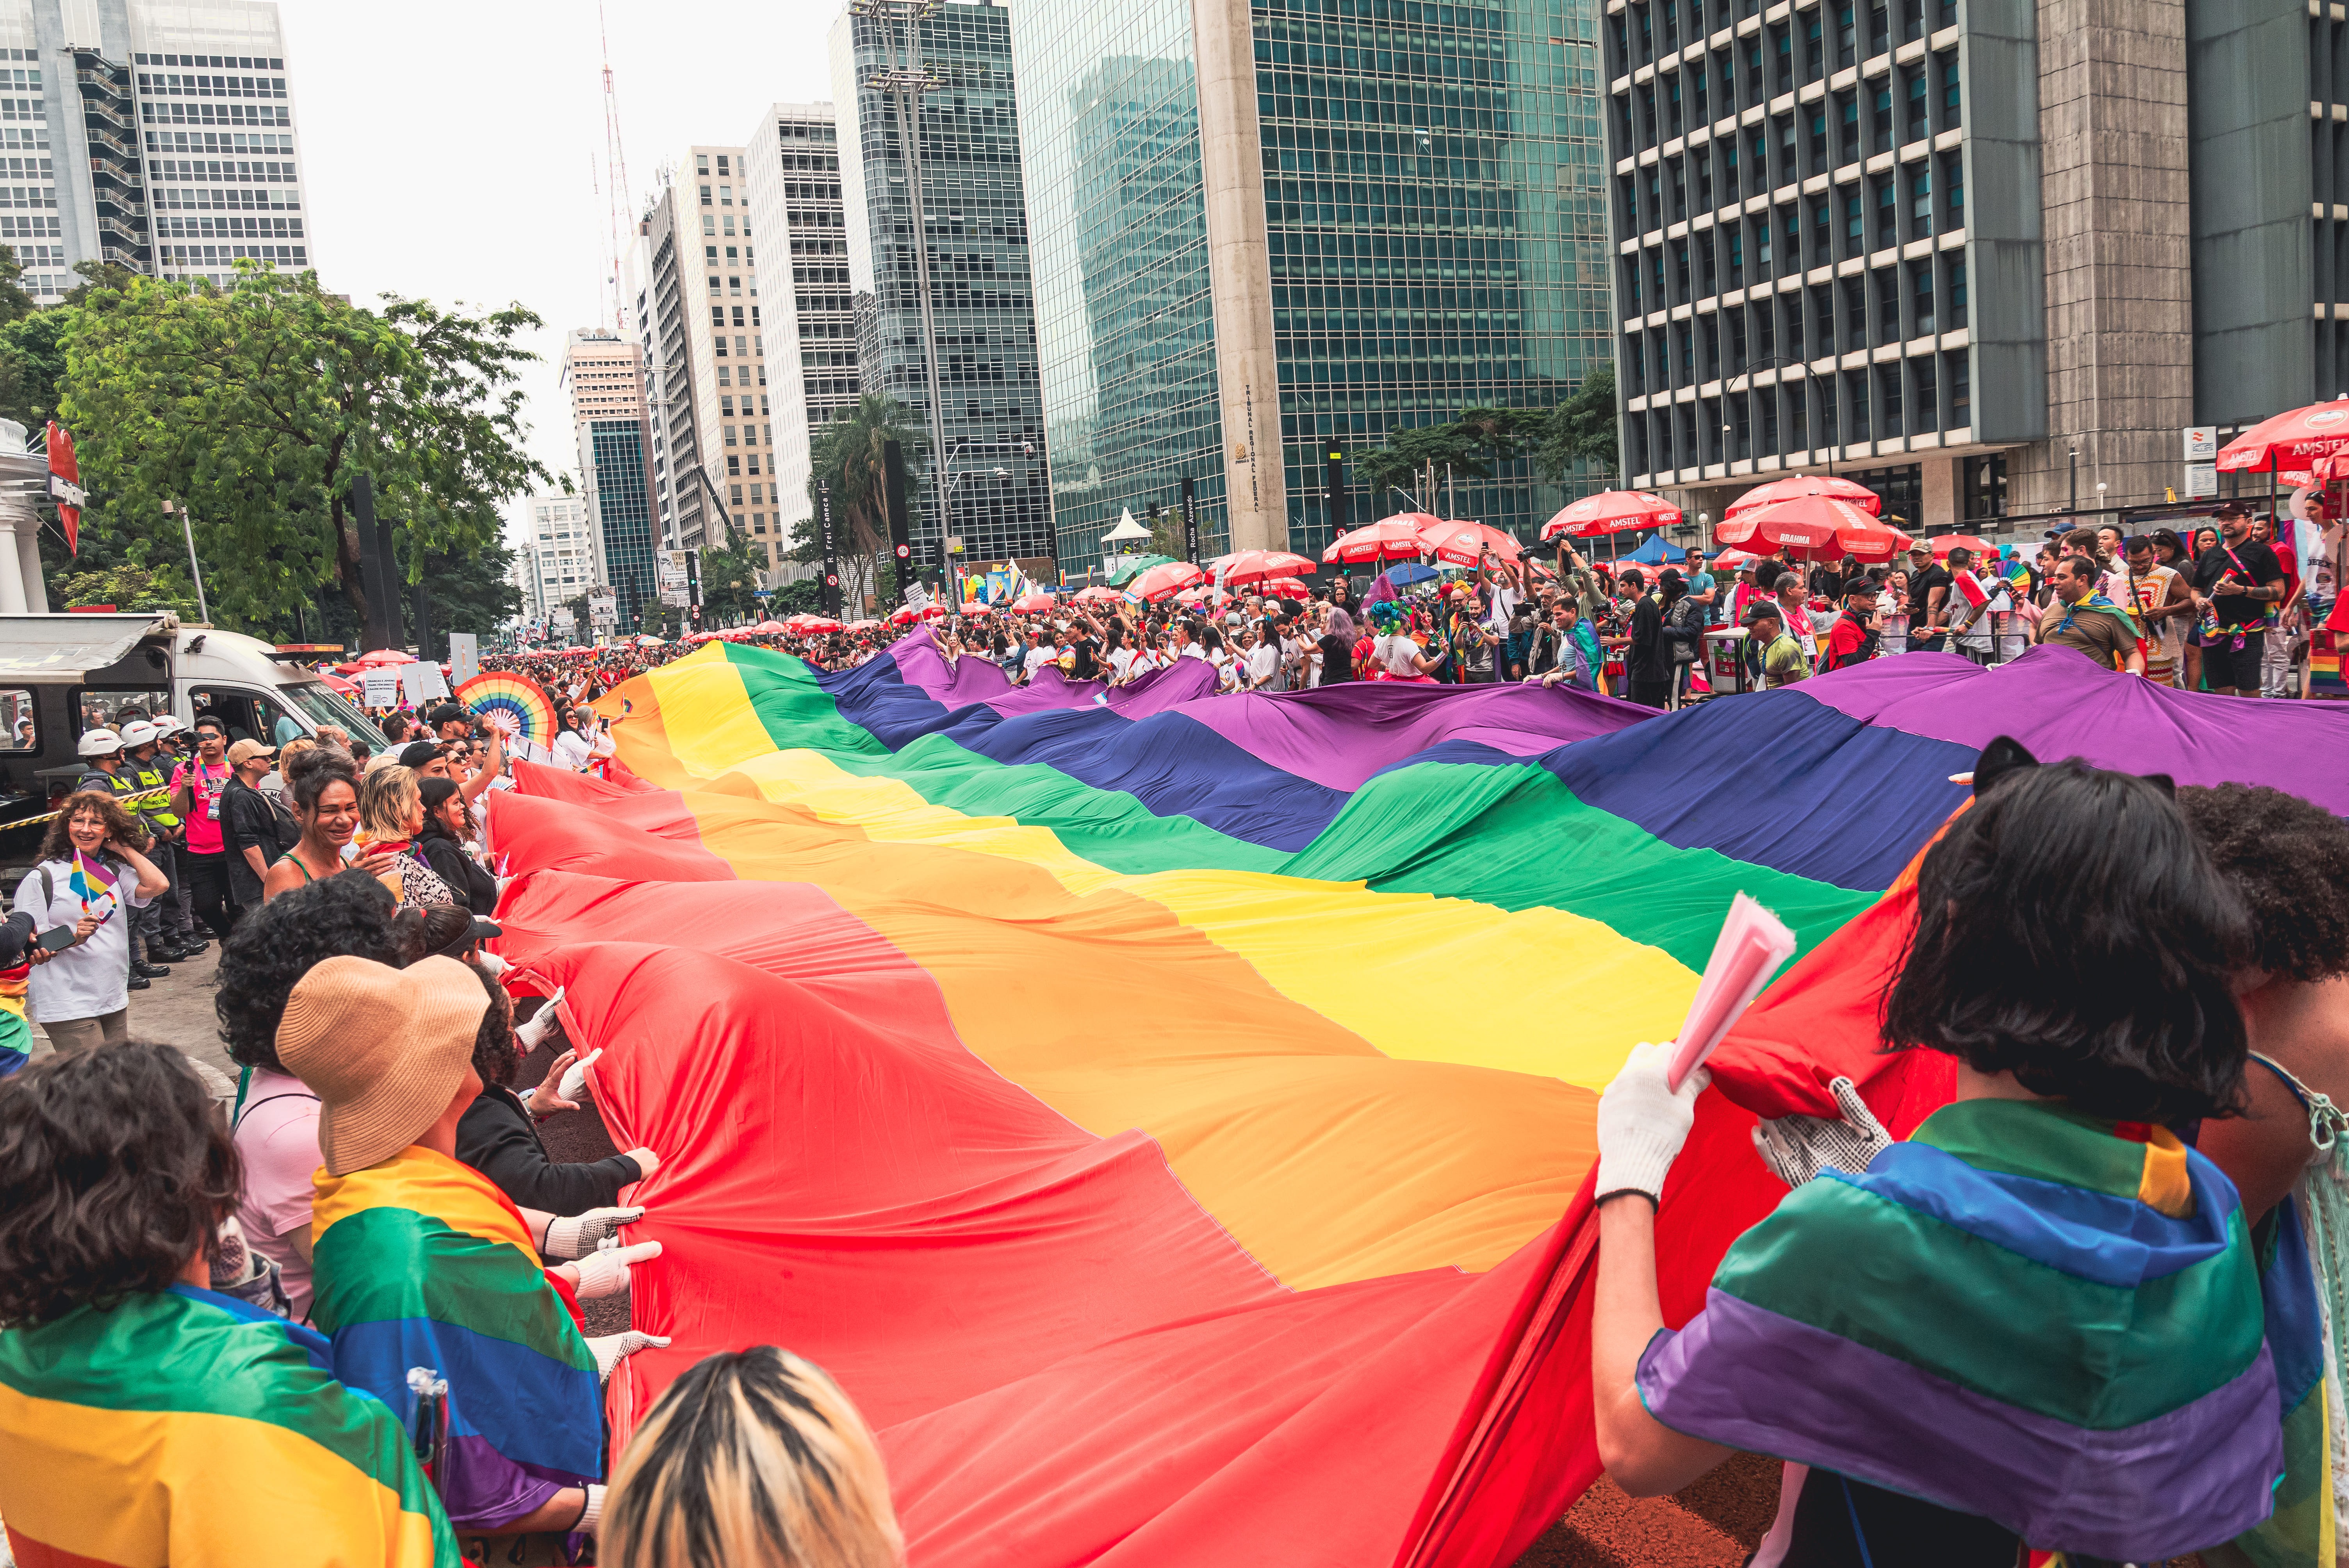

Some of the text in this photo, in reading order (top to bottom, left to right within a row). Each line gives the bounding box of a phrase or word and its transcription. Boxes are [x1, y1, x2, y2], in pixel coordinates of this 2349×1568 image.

[2228, 450, 2258, 464] AMSTEL
[2283, 471, 2309, 483] AMSTEL
[1609, 517, 1641, 528] AMSTEL
[1658, 513, 1677, 522] AMSTEL
[1562, 524, 1586, 533] AMSTEL
[825, 532, 833, 550] Frei
[1779, 533, 1810, 544] BRAHMA
[1349, 544, 1373, 554] AMSTEL
[1416, 540, 1432, 552] AMSTEL
[827, 554, 834, 563] R.
[1445, 552, 1471, 564] AMSTEL
[1184, 577, 1197, 587] AMSTEL
[1154, 589, 1173, 600] AMSTEL
